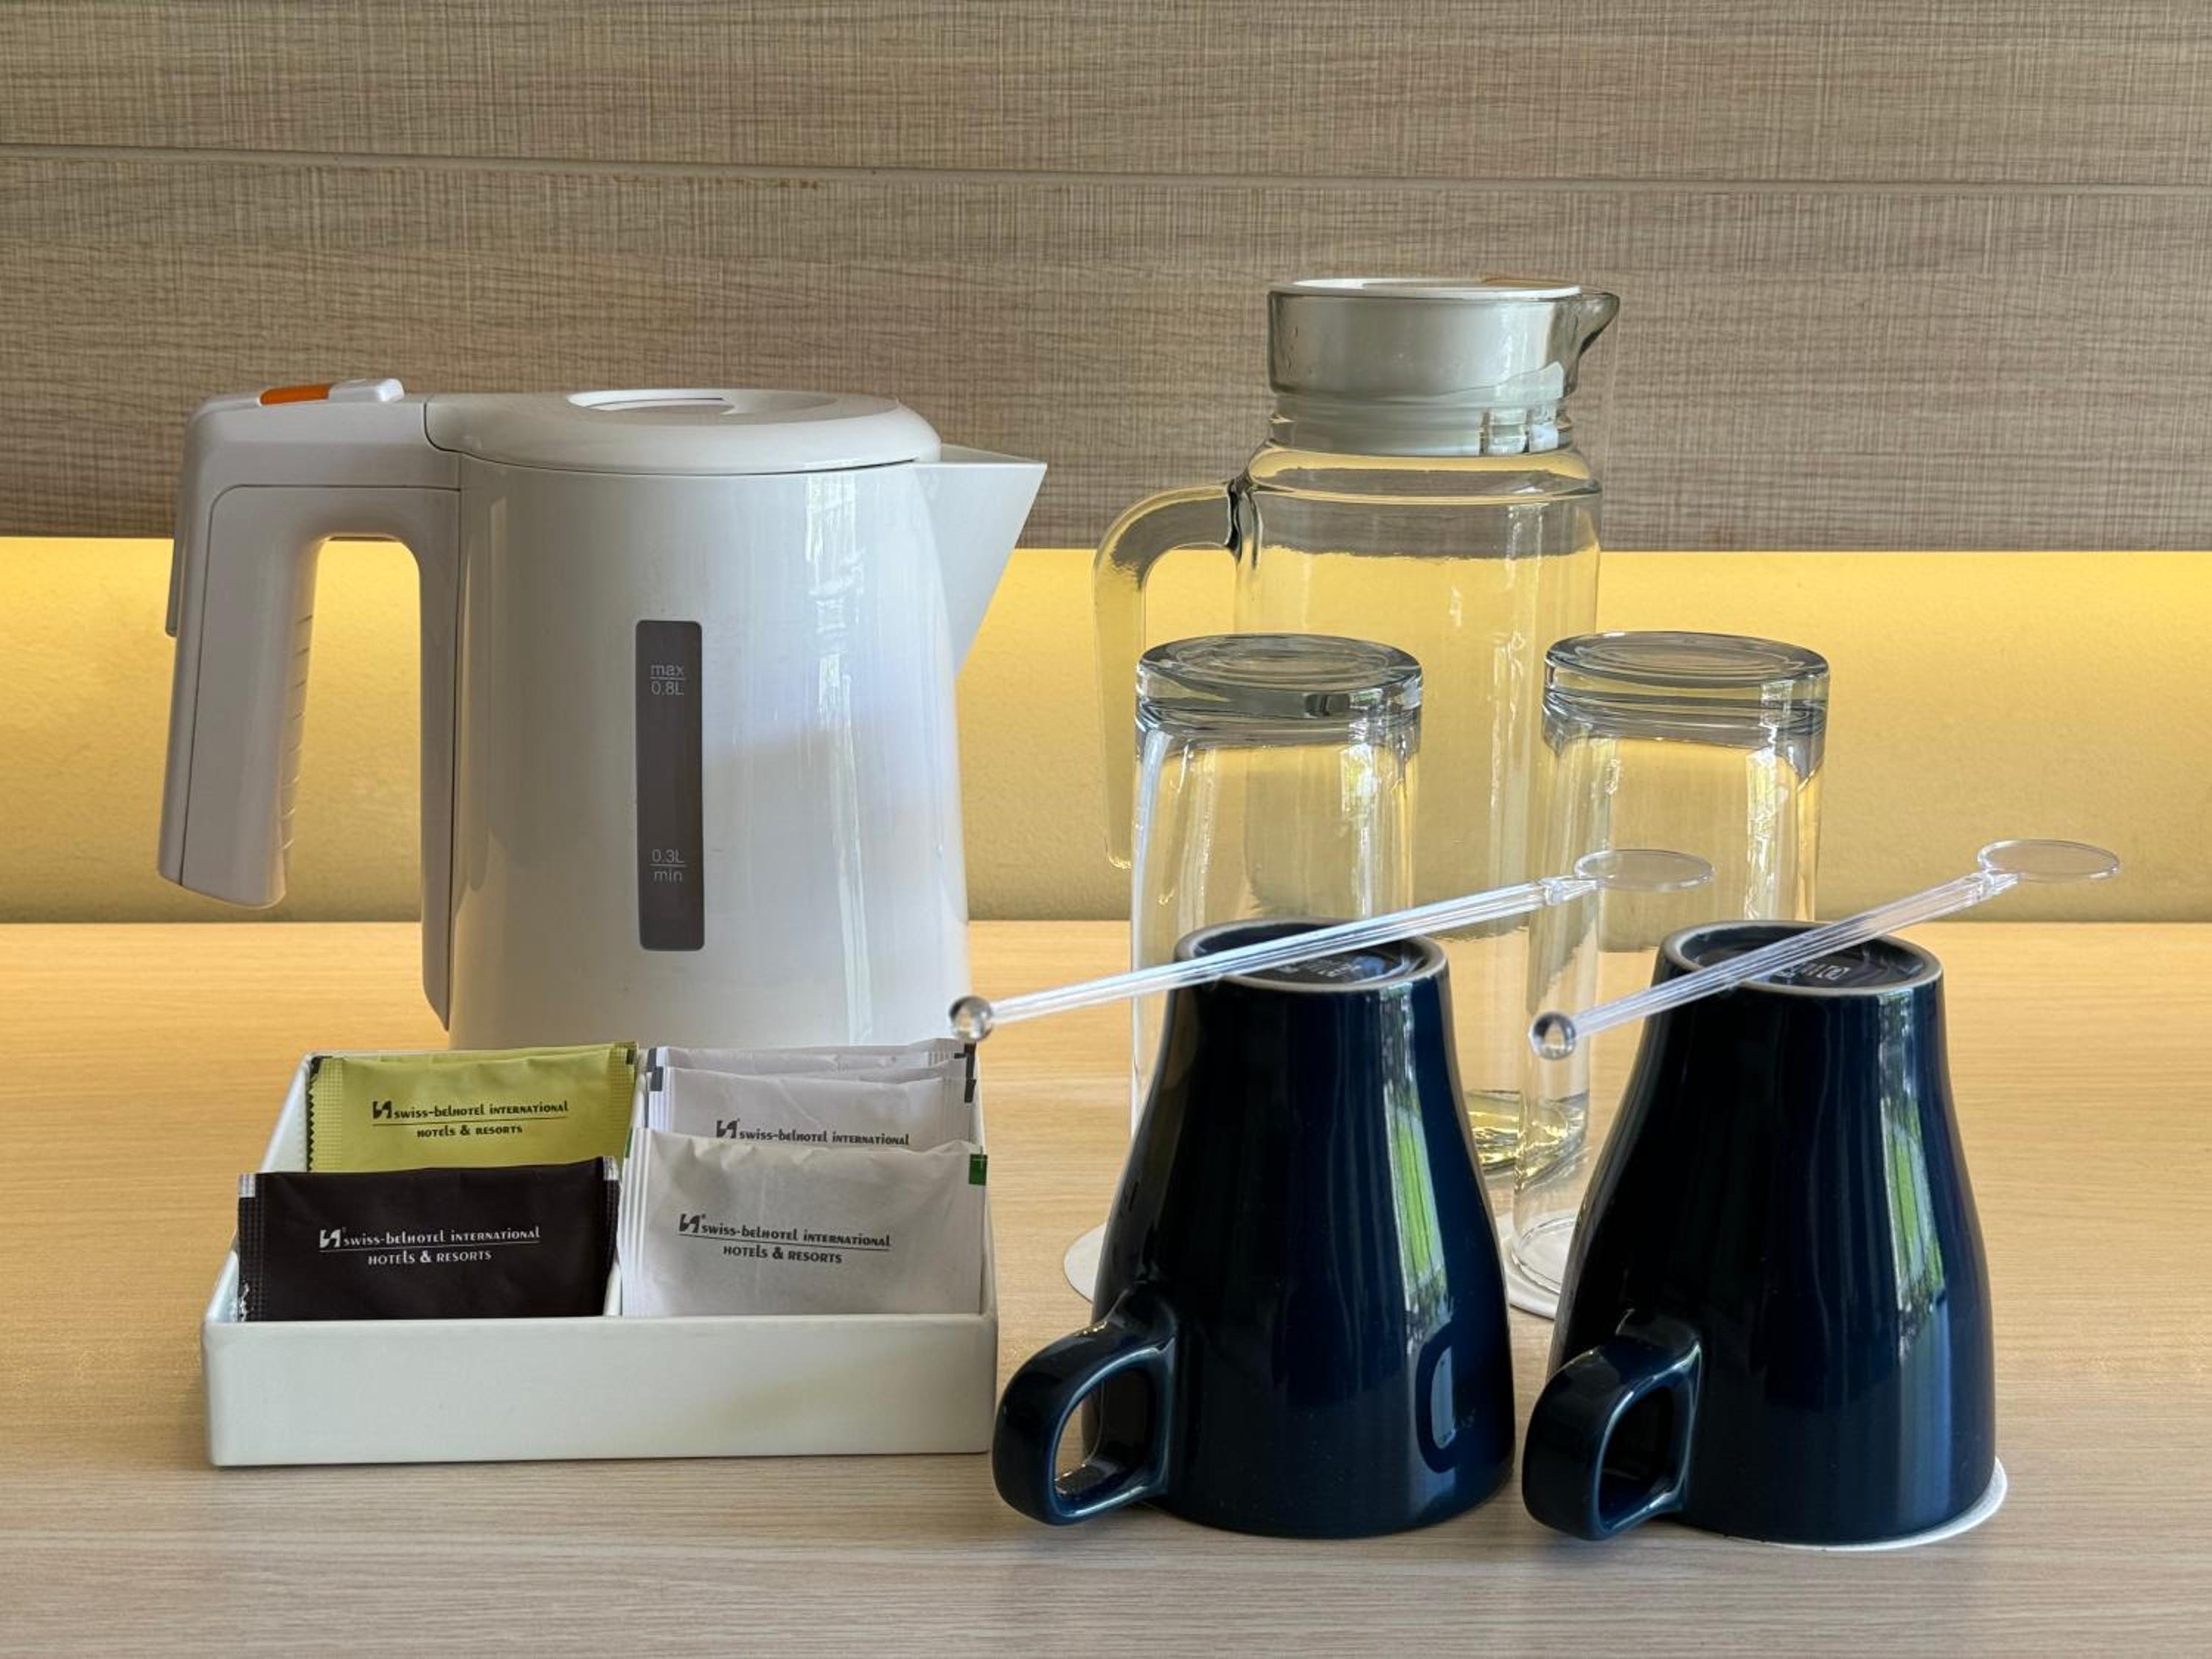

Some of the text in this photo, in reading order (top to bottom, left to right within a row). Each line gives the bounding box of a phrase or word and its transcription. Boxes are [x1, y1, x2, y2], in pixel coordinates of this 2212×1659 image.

[651, 664, 685, 676] max
[651, 681, 685, 695] 0.8L
[652, 849, 684, 863] 0.3L
[653, 869, 683, 883] min
[460, 1125, 470, 1135] &
[476, 1125, 523, 1134] RESORTS
[420, 1251, 431, 1263] &
[437, 1251, 491, 1262] RESORTS
[773, 1246, 783, 1259] &
[787, 1251, 842, 1264] RESORTS
